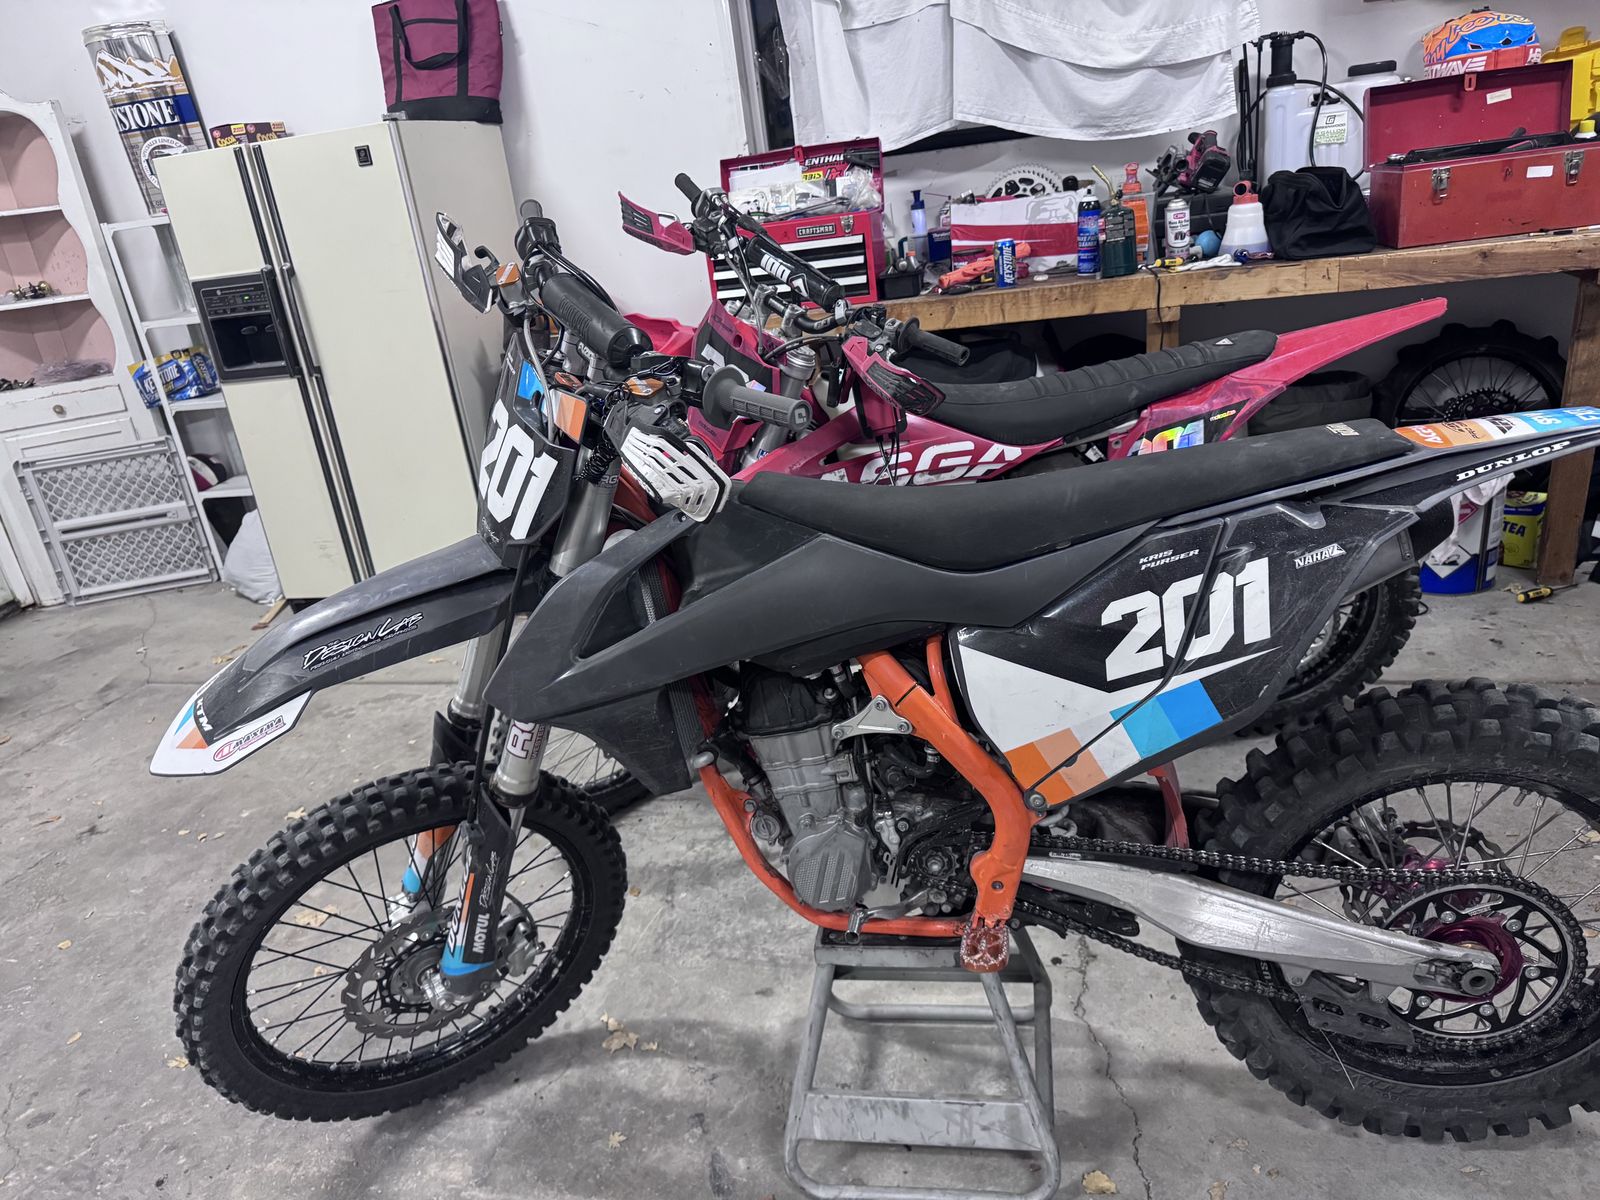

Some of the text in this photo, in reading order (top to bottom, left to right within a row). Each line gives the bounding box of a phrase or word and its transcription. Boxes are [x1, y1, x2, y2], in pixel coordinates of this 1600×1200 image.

[798, 225, 834, 237] CRAFTSMAN
[1002, 244, 1014, 284] KEYSTONE
[479, 398, 559, 540] 201
[1456, 441, 1571, 482] DUNLOP
[1139, 549, 1174, 564] KRIS
[1141, 549, 1200, 570] PURSER
[1100, 556, 1272, 682] 201
[196, 697, 213, 732] KTM
[472, 913, 490, 954] MOTUL
